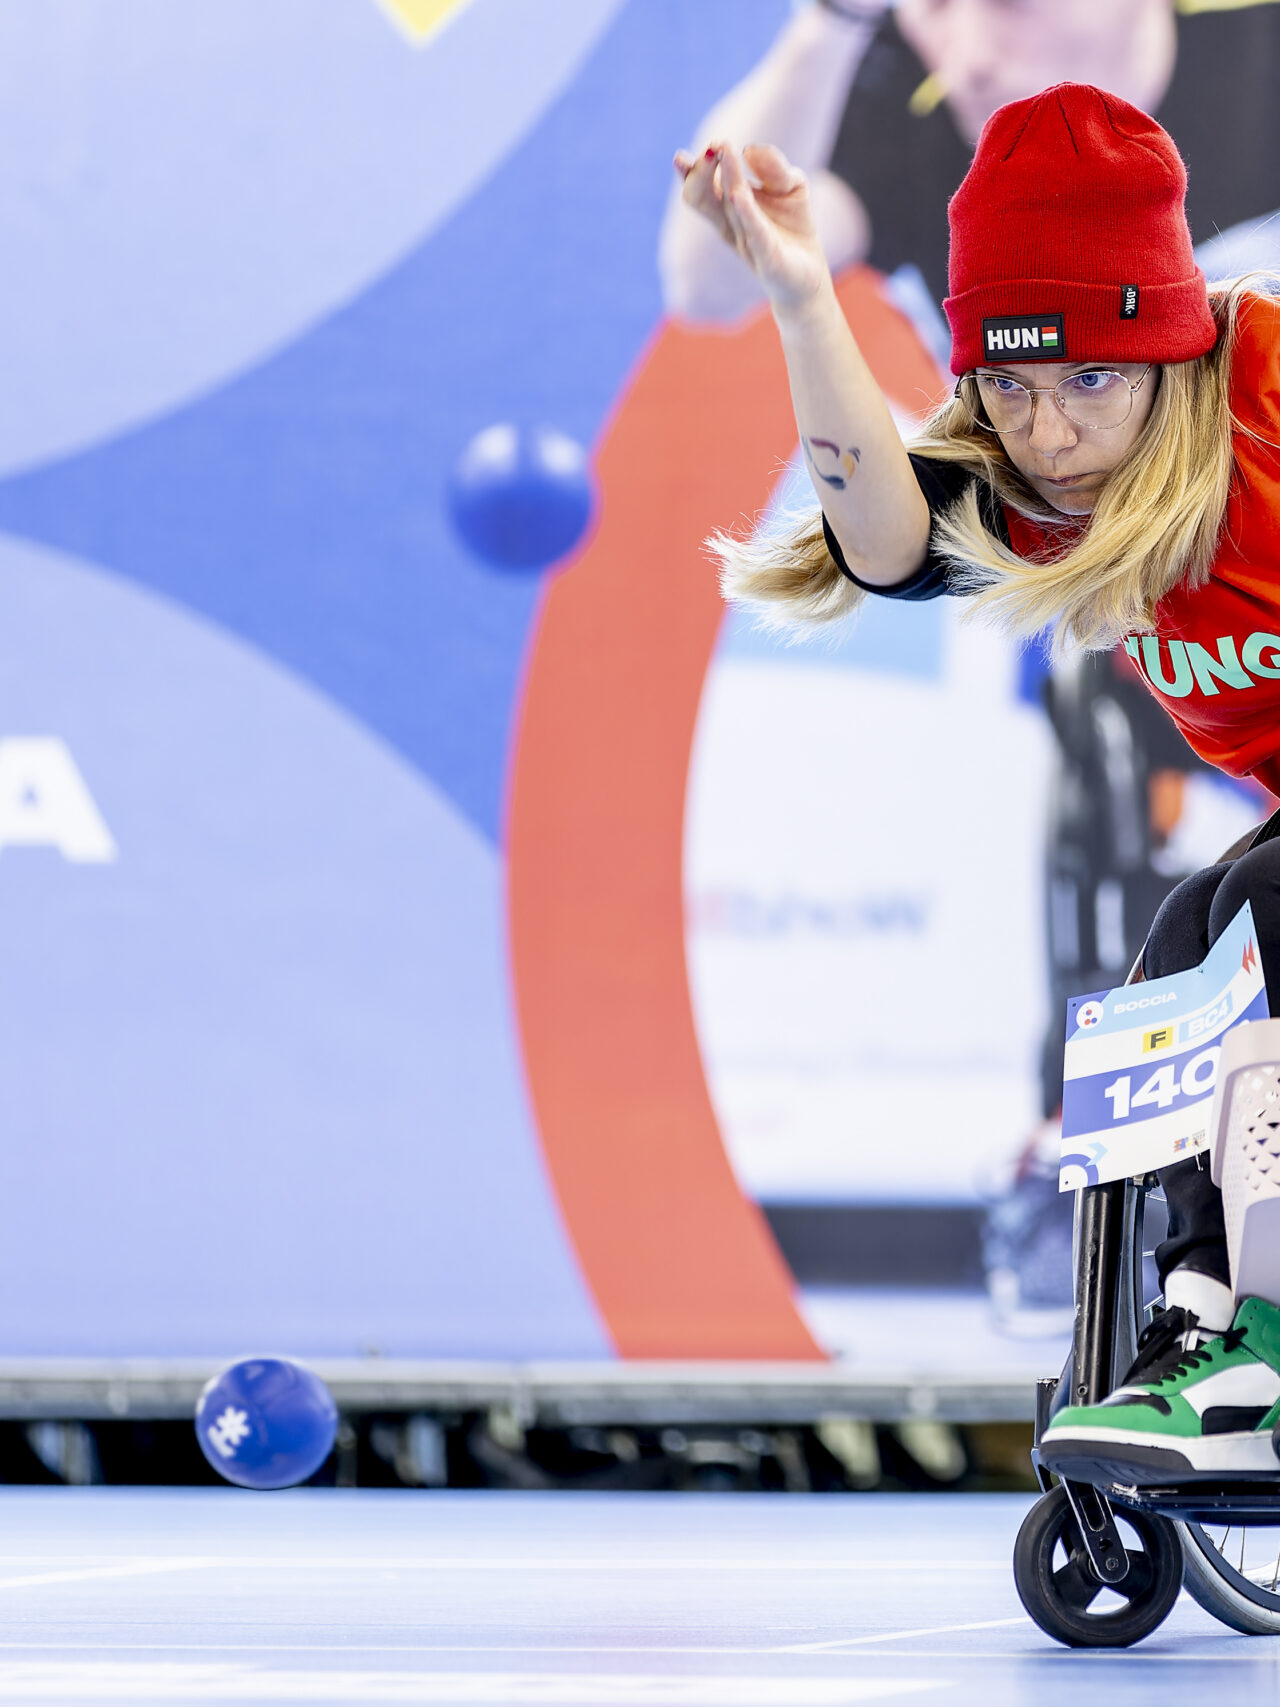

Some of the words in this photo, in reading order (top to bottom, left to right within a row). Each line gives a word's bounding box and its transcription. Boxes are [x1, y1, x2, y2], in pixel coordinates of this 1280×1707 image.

[987, 326, 1040, 351] HUN
[1113, 991, 1177, 1015] BOCCIA
[1150, 1030, 1167, 1050] F
[1188, 998, 1229, 1038] BC4
[1104, 1019, 1250, 1120] 140
